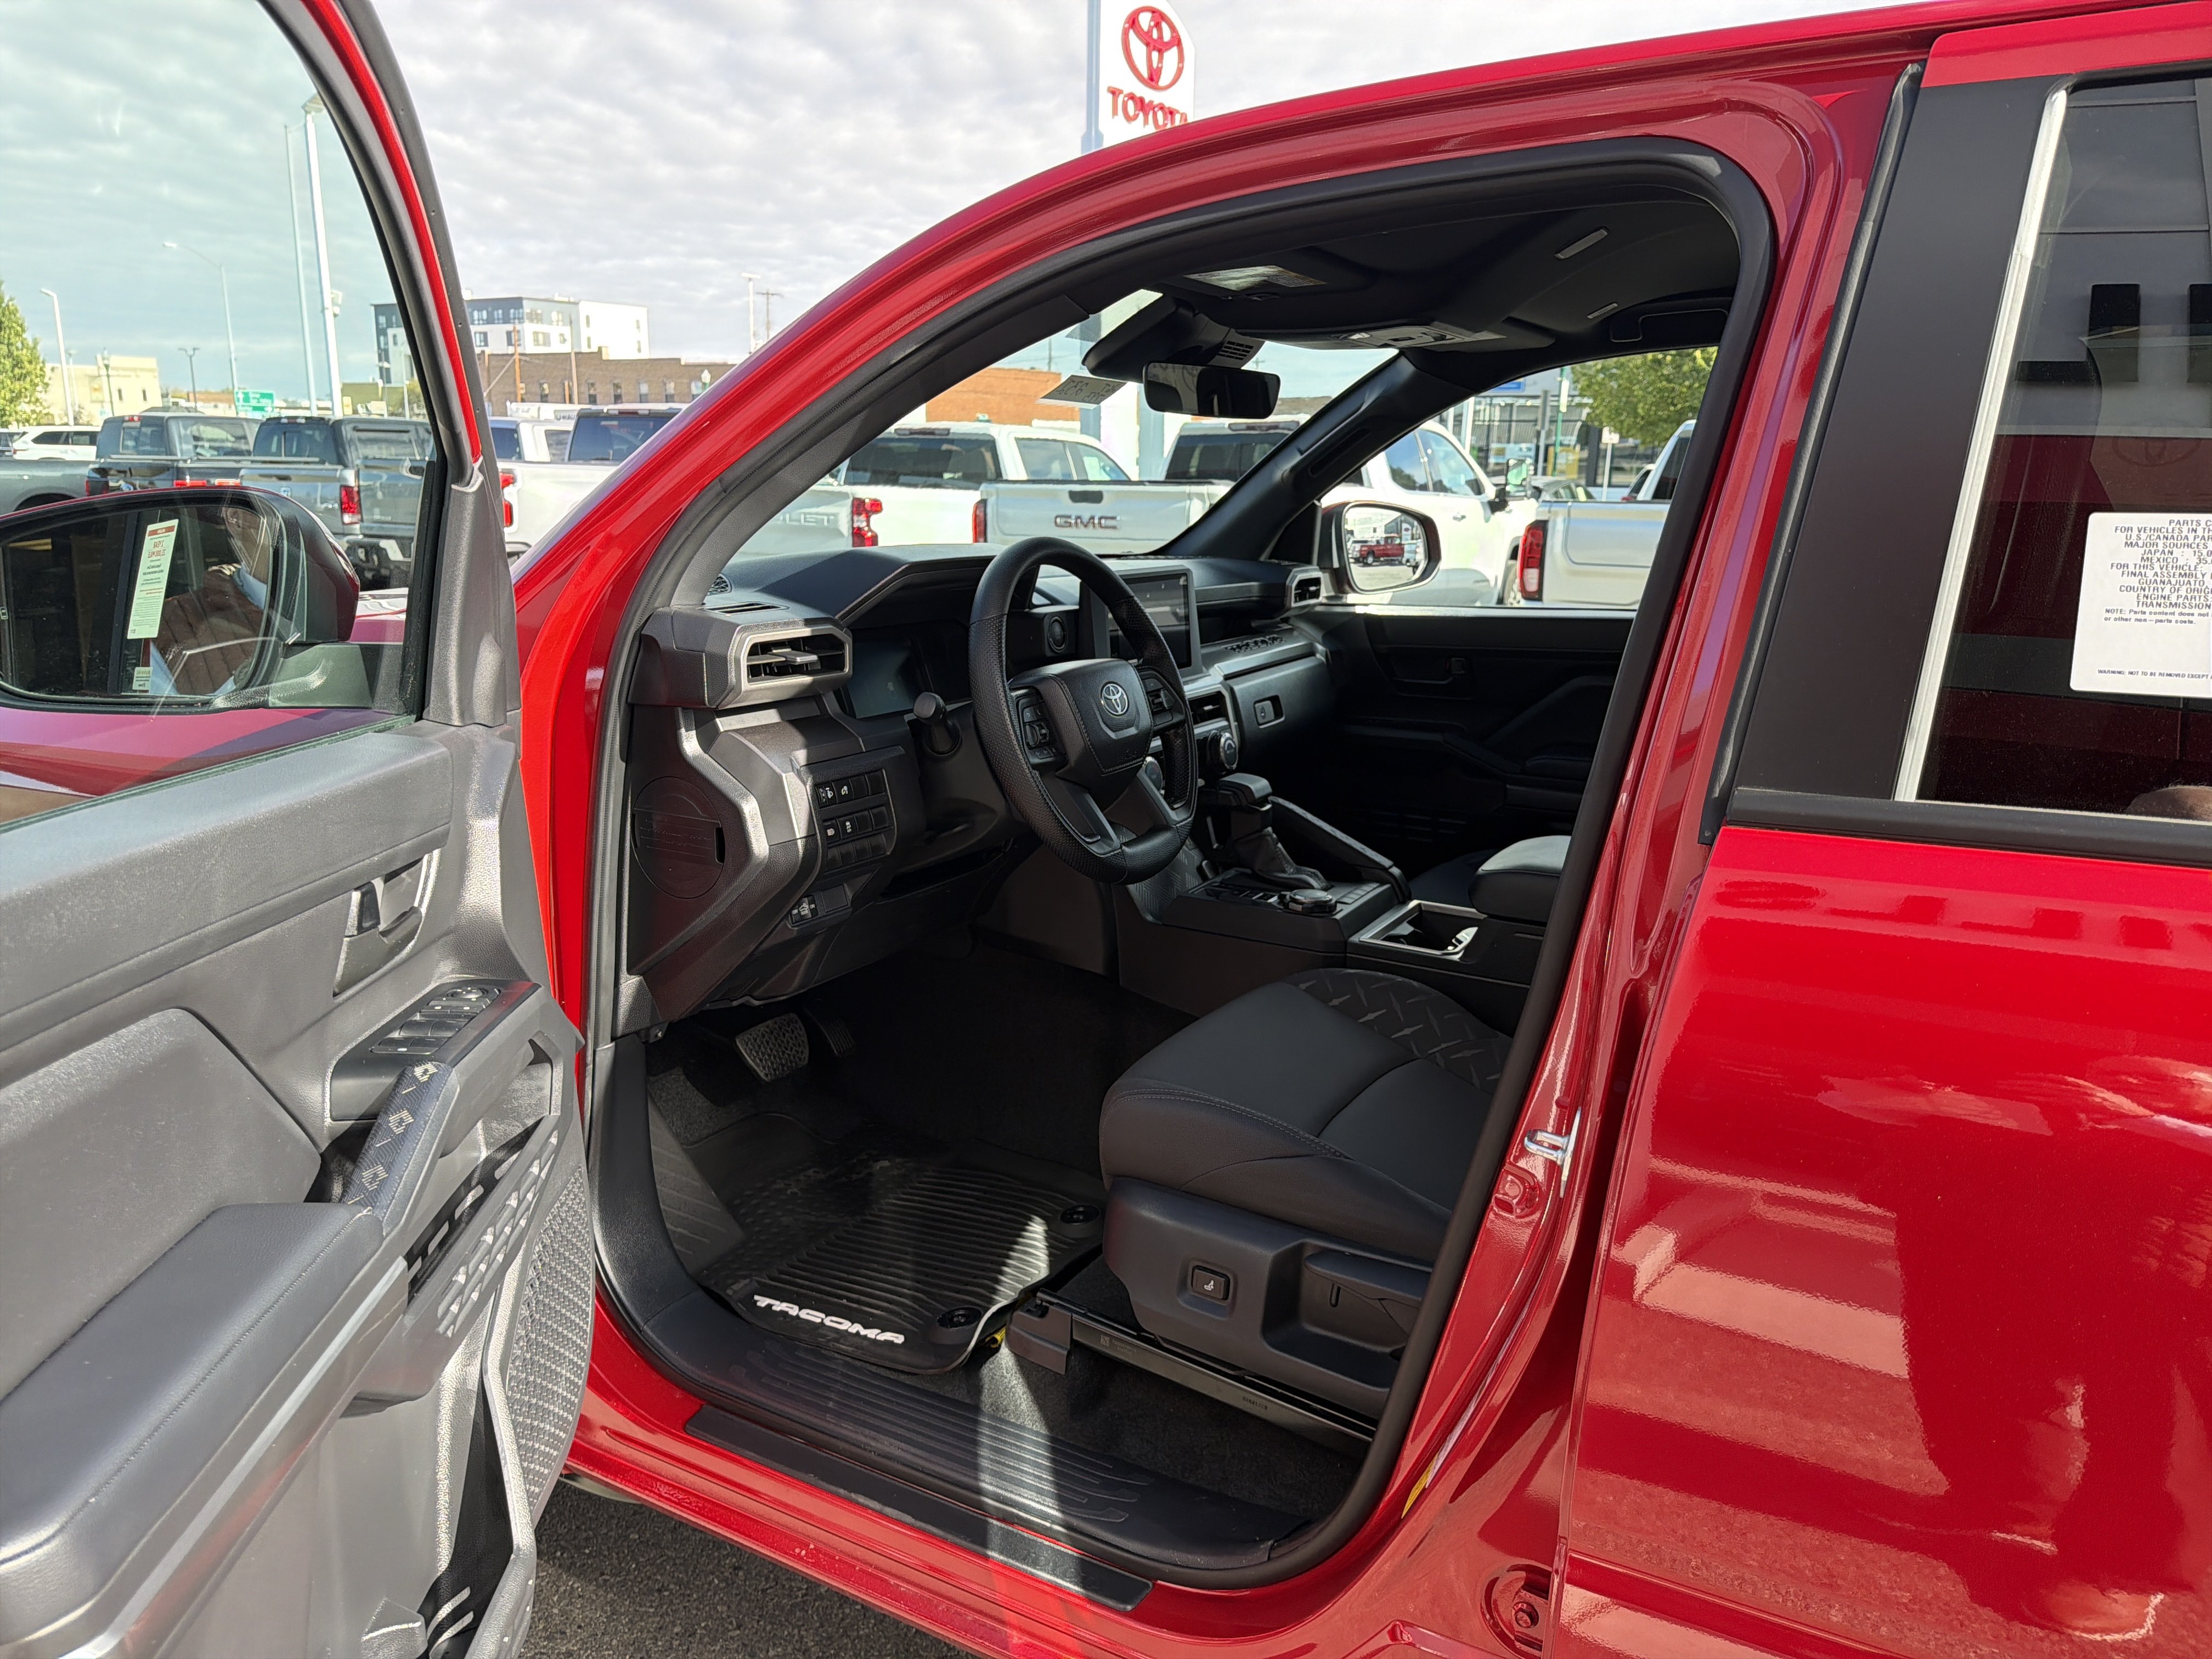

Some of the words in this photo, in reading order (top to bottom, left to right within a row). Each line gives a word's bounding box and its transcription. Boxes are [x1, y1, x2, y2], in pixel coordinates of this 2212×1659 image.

[1054, 515, 1120, 529] GMC
[2125, 533, 2189, 541] U.S./CANADA
[2196, 557, 2212, 565] 35.
[2159, 563, 2203, 572] VEHICLE:
[2152, 571, 2207, 579] ASSEMBLY
[2119, 585, 2166, 593] COUNTRY
[2136, 600, 2211, 610] TRANSMISSION
[753, 1294, 905, 1344] TACOMA
